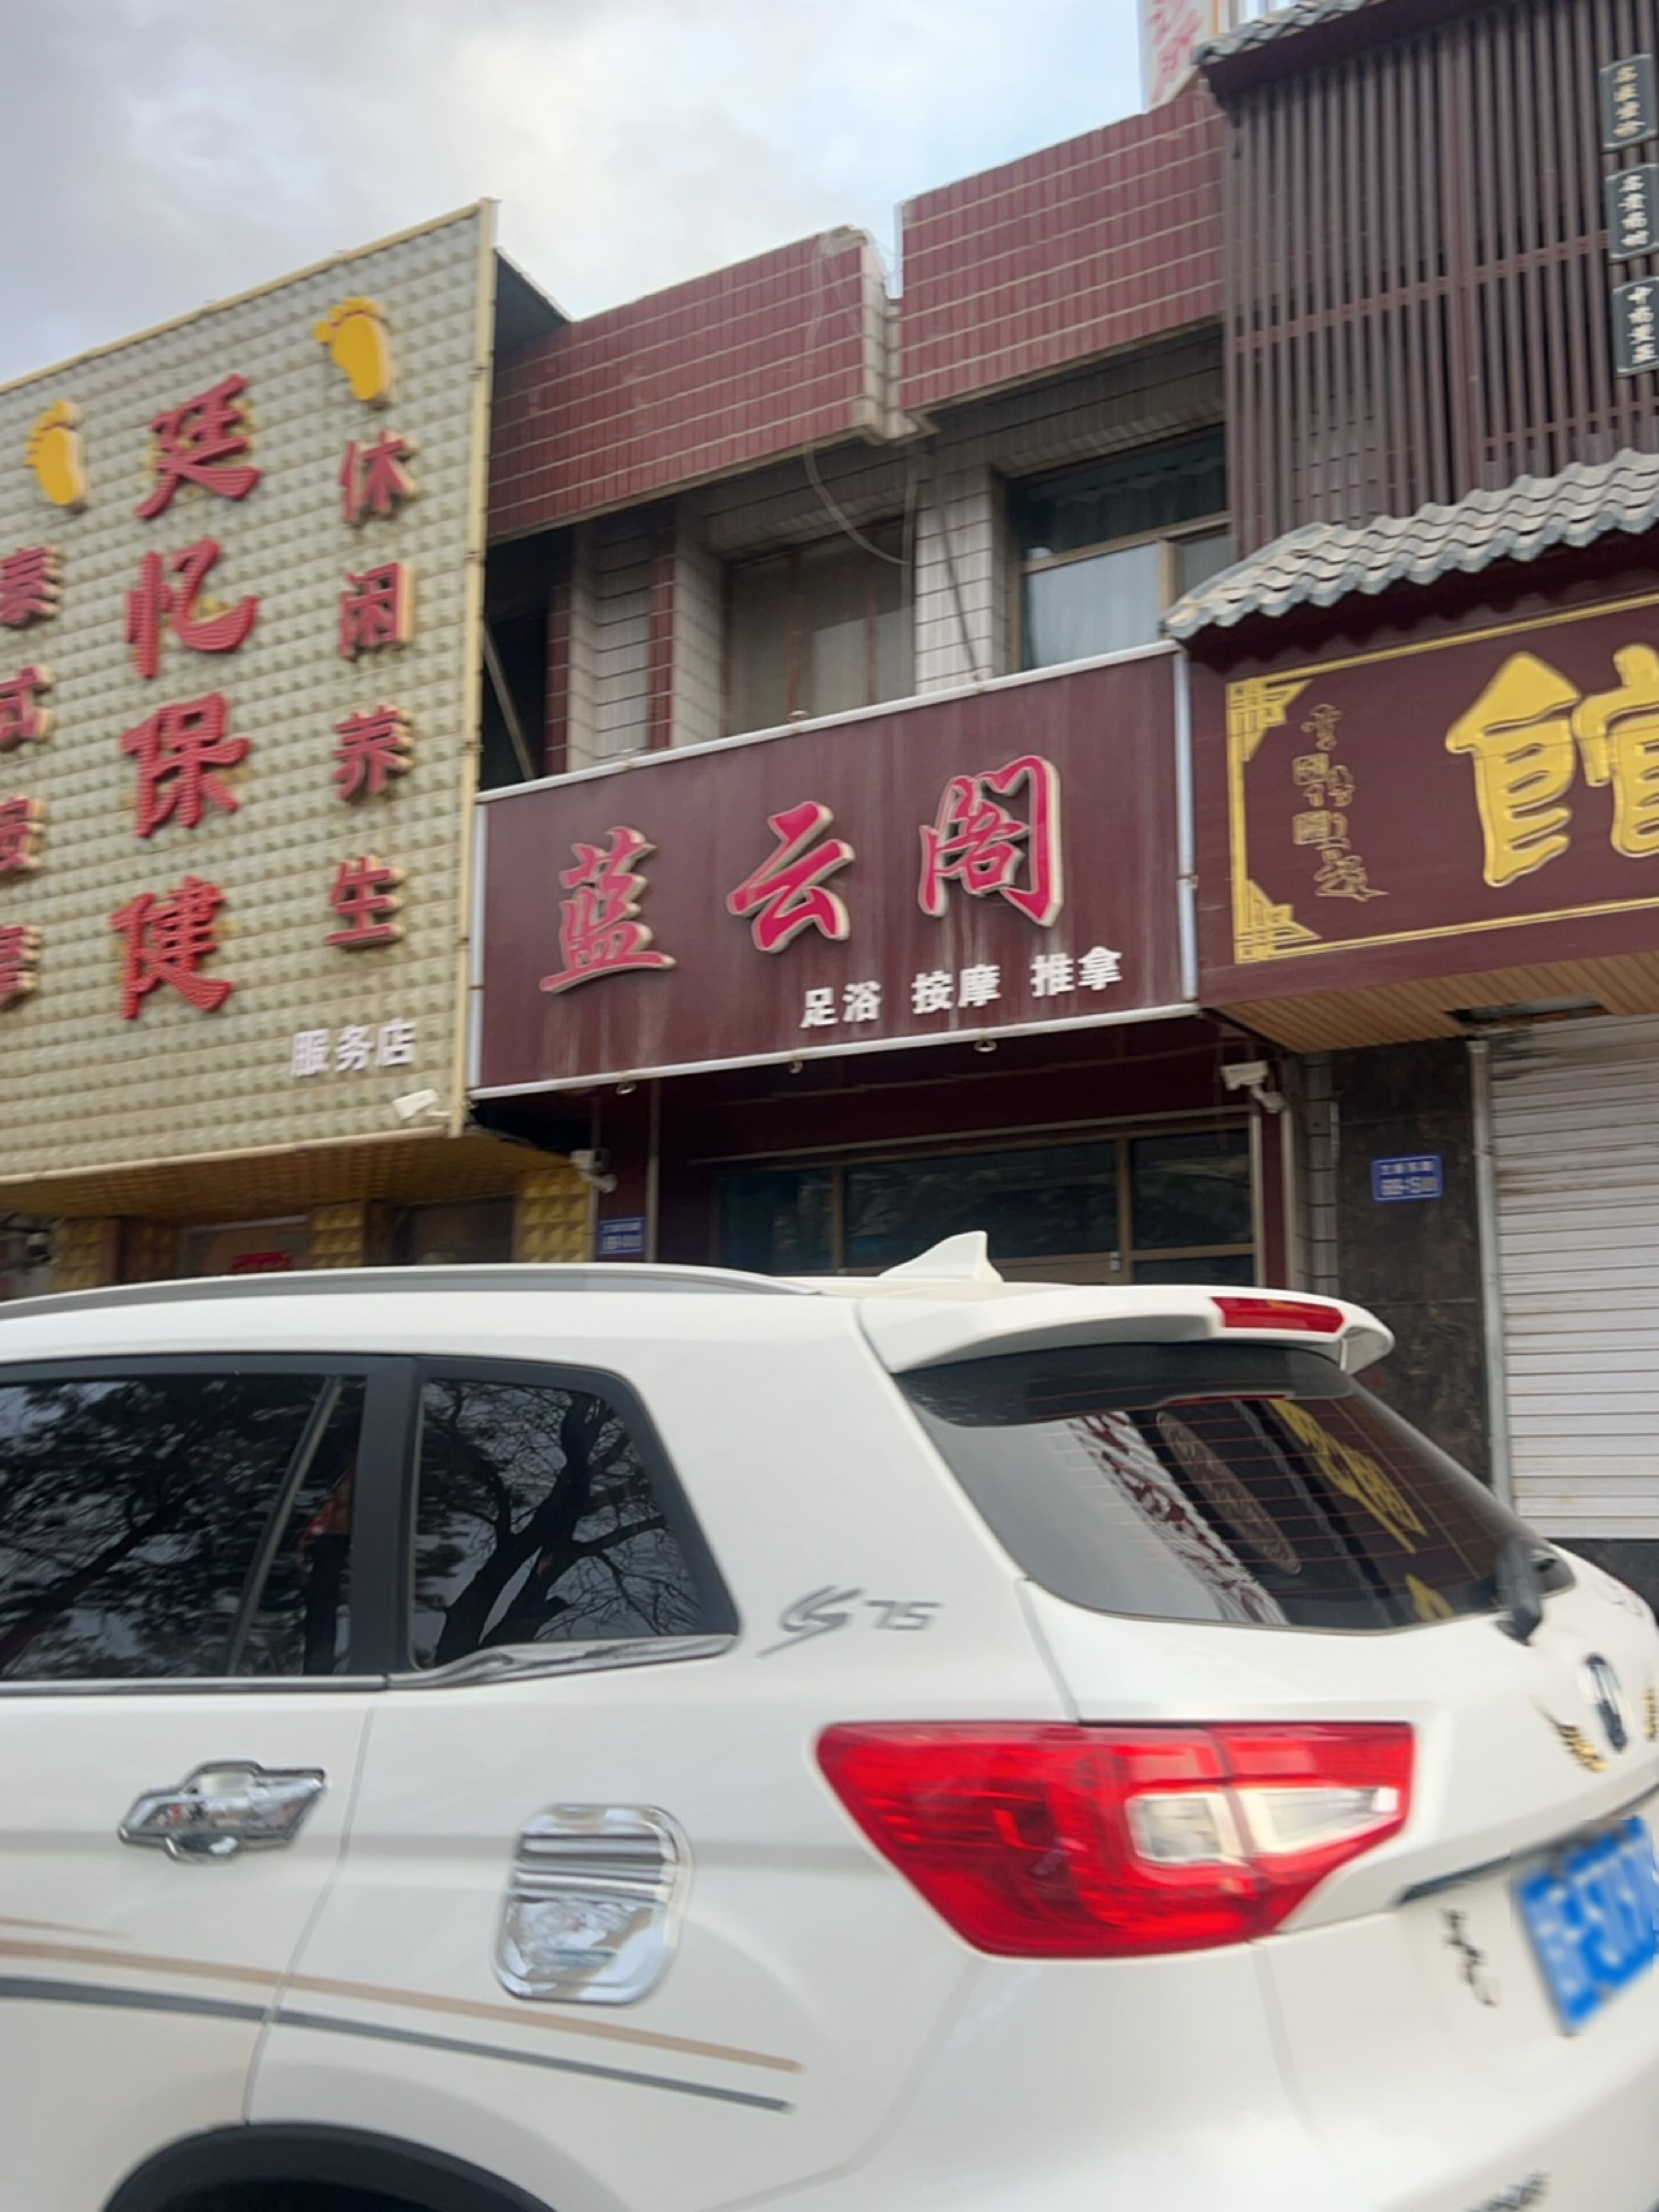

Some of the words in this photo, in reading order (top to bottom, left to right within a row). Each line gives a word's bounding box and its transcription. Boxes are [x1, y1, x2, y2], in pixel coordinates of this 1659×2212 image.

[326, 429, 415, 947] 休闲养生
[799, 981, 882, 1029] 足浴
[911, 964, 1001, 1015] 按摩
[1030, 947, 1123, 998] 推拿
[290, 1018, 417, 1078] 服务店
